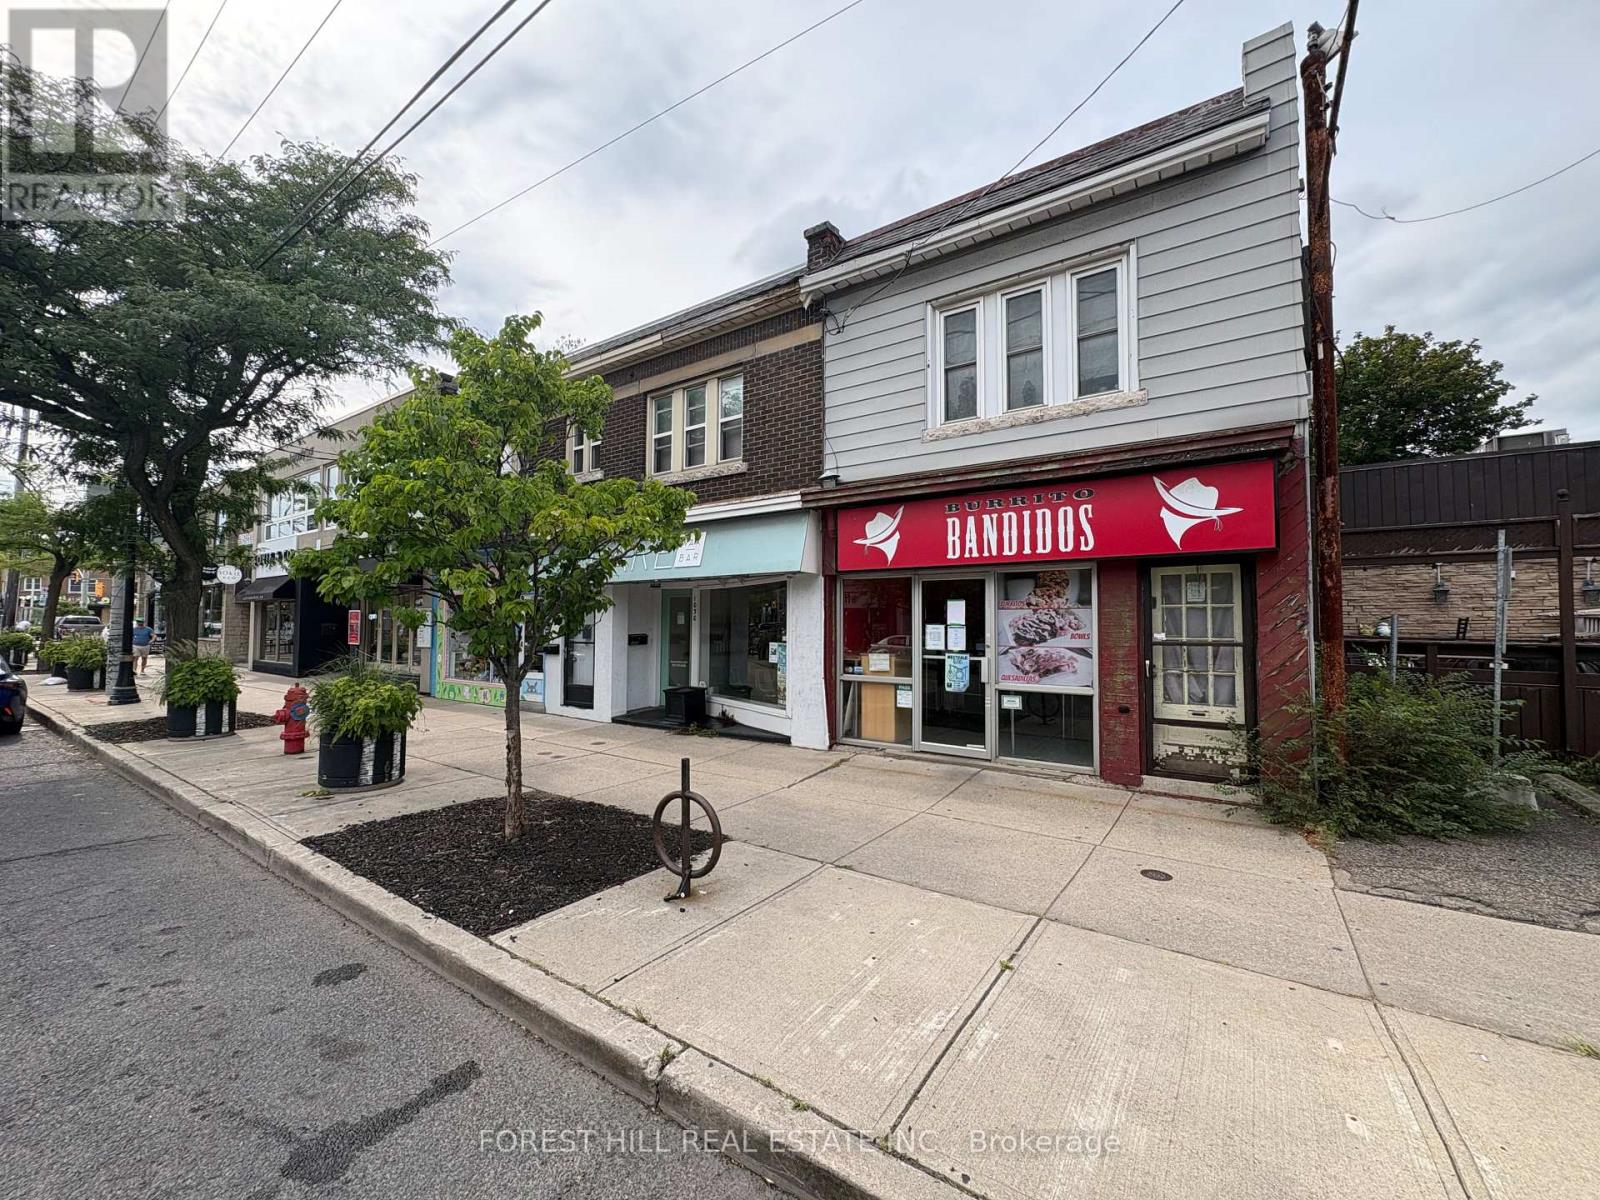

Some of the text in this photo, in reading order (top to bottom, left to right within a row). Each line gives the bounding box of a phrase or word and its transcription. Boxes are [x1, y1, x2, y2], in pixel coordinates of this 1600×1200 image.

[945, 488, 1095, 513] BURRITO
[946, 504, 1095, 559] BANDIDOS
[679, 553, 698, 562] BAR
